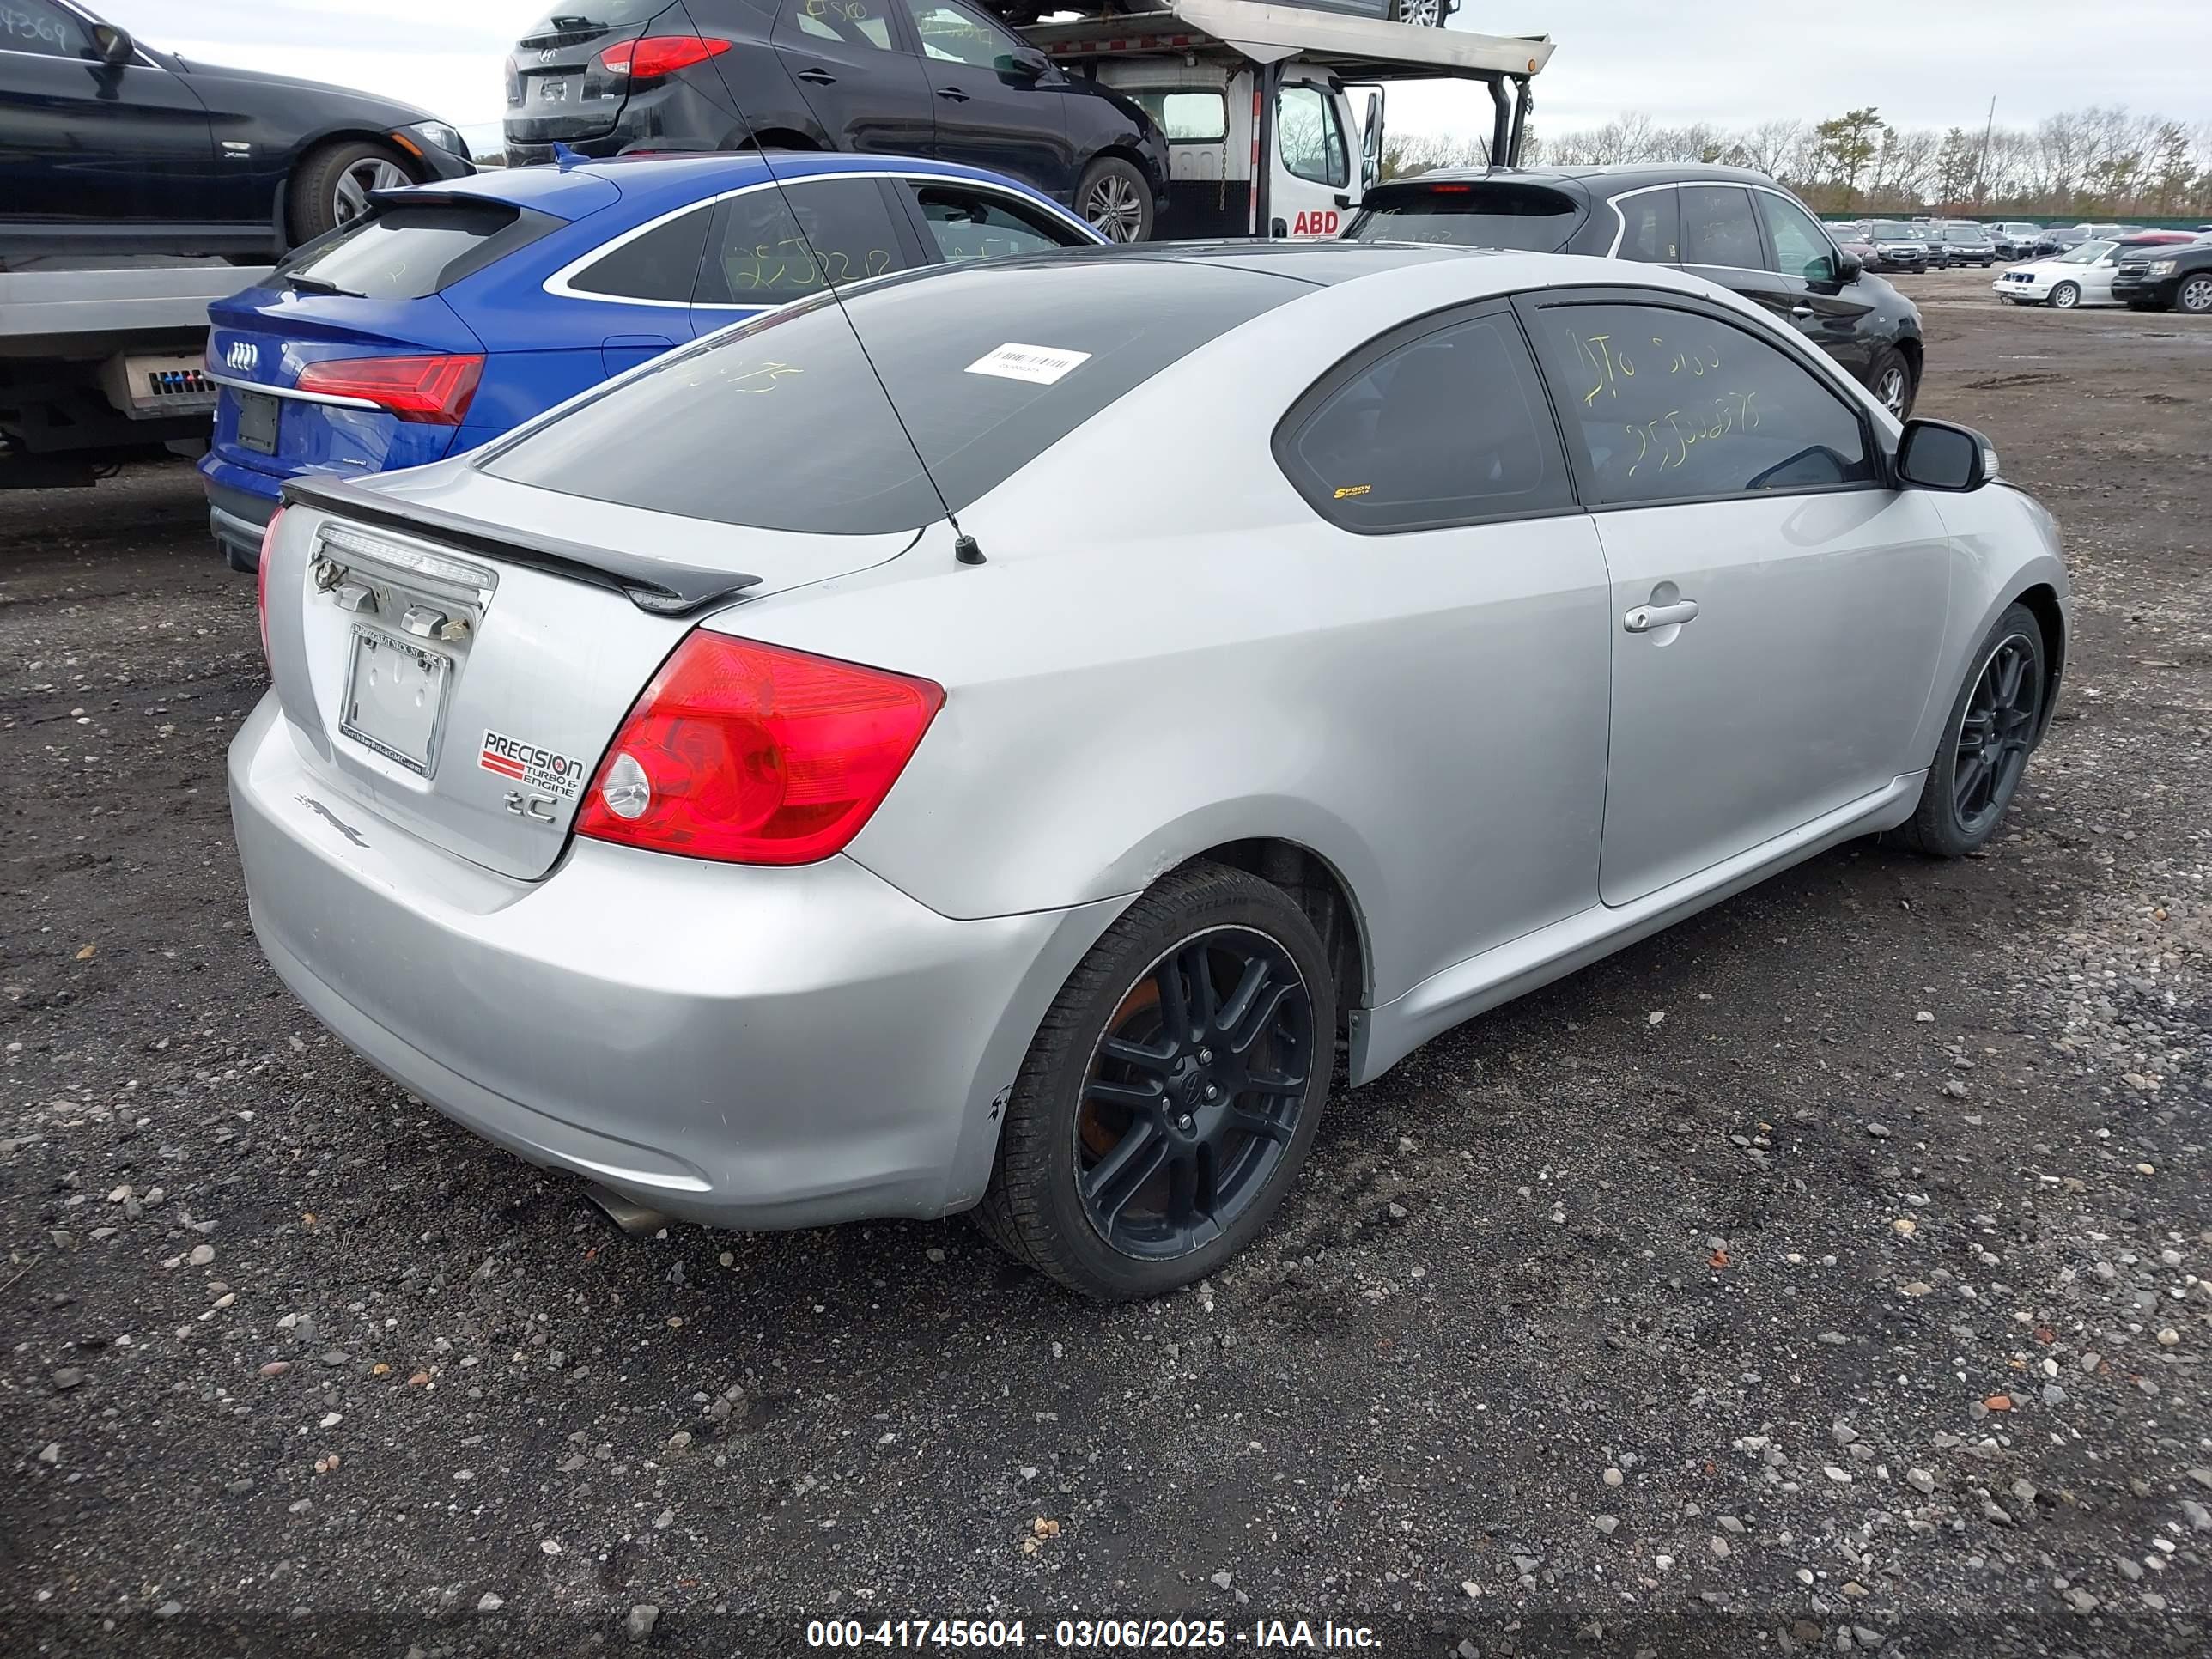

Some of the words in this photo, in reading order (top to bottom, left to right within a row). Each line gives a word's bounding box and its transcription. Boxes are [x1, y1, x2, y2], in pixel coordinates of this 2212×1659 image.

[1293, 210, 1339, 234] ABD
[1333, 484, 1372, 499] SPOON
[342, 726, 422, 774] NorthBayBuickGMC.com
[483, 732, 584, 781] PRECISION
[523, 775, 575, 798] ENGINE
[526, 765, 567, 786] TURBO
[567, 780, 579, 790] &
